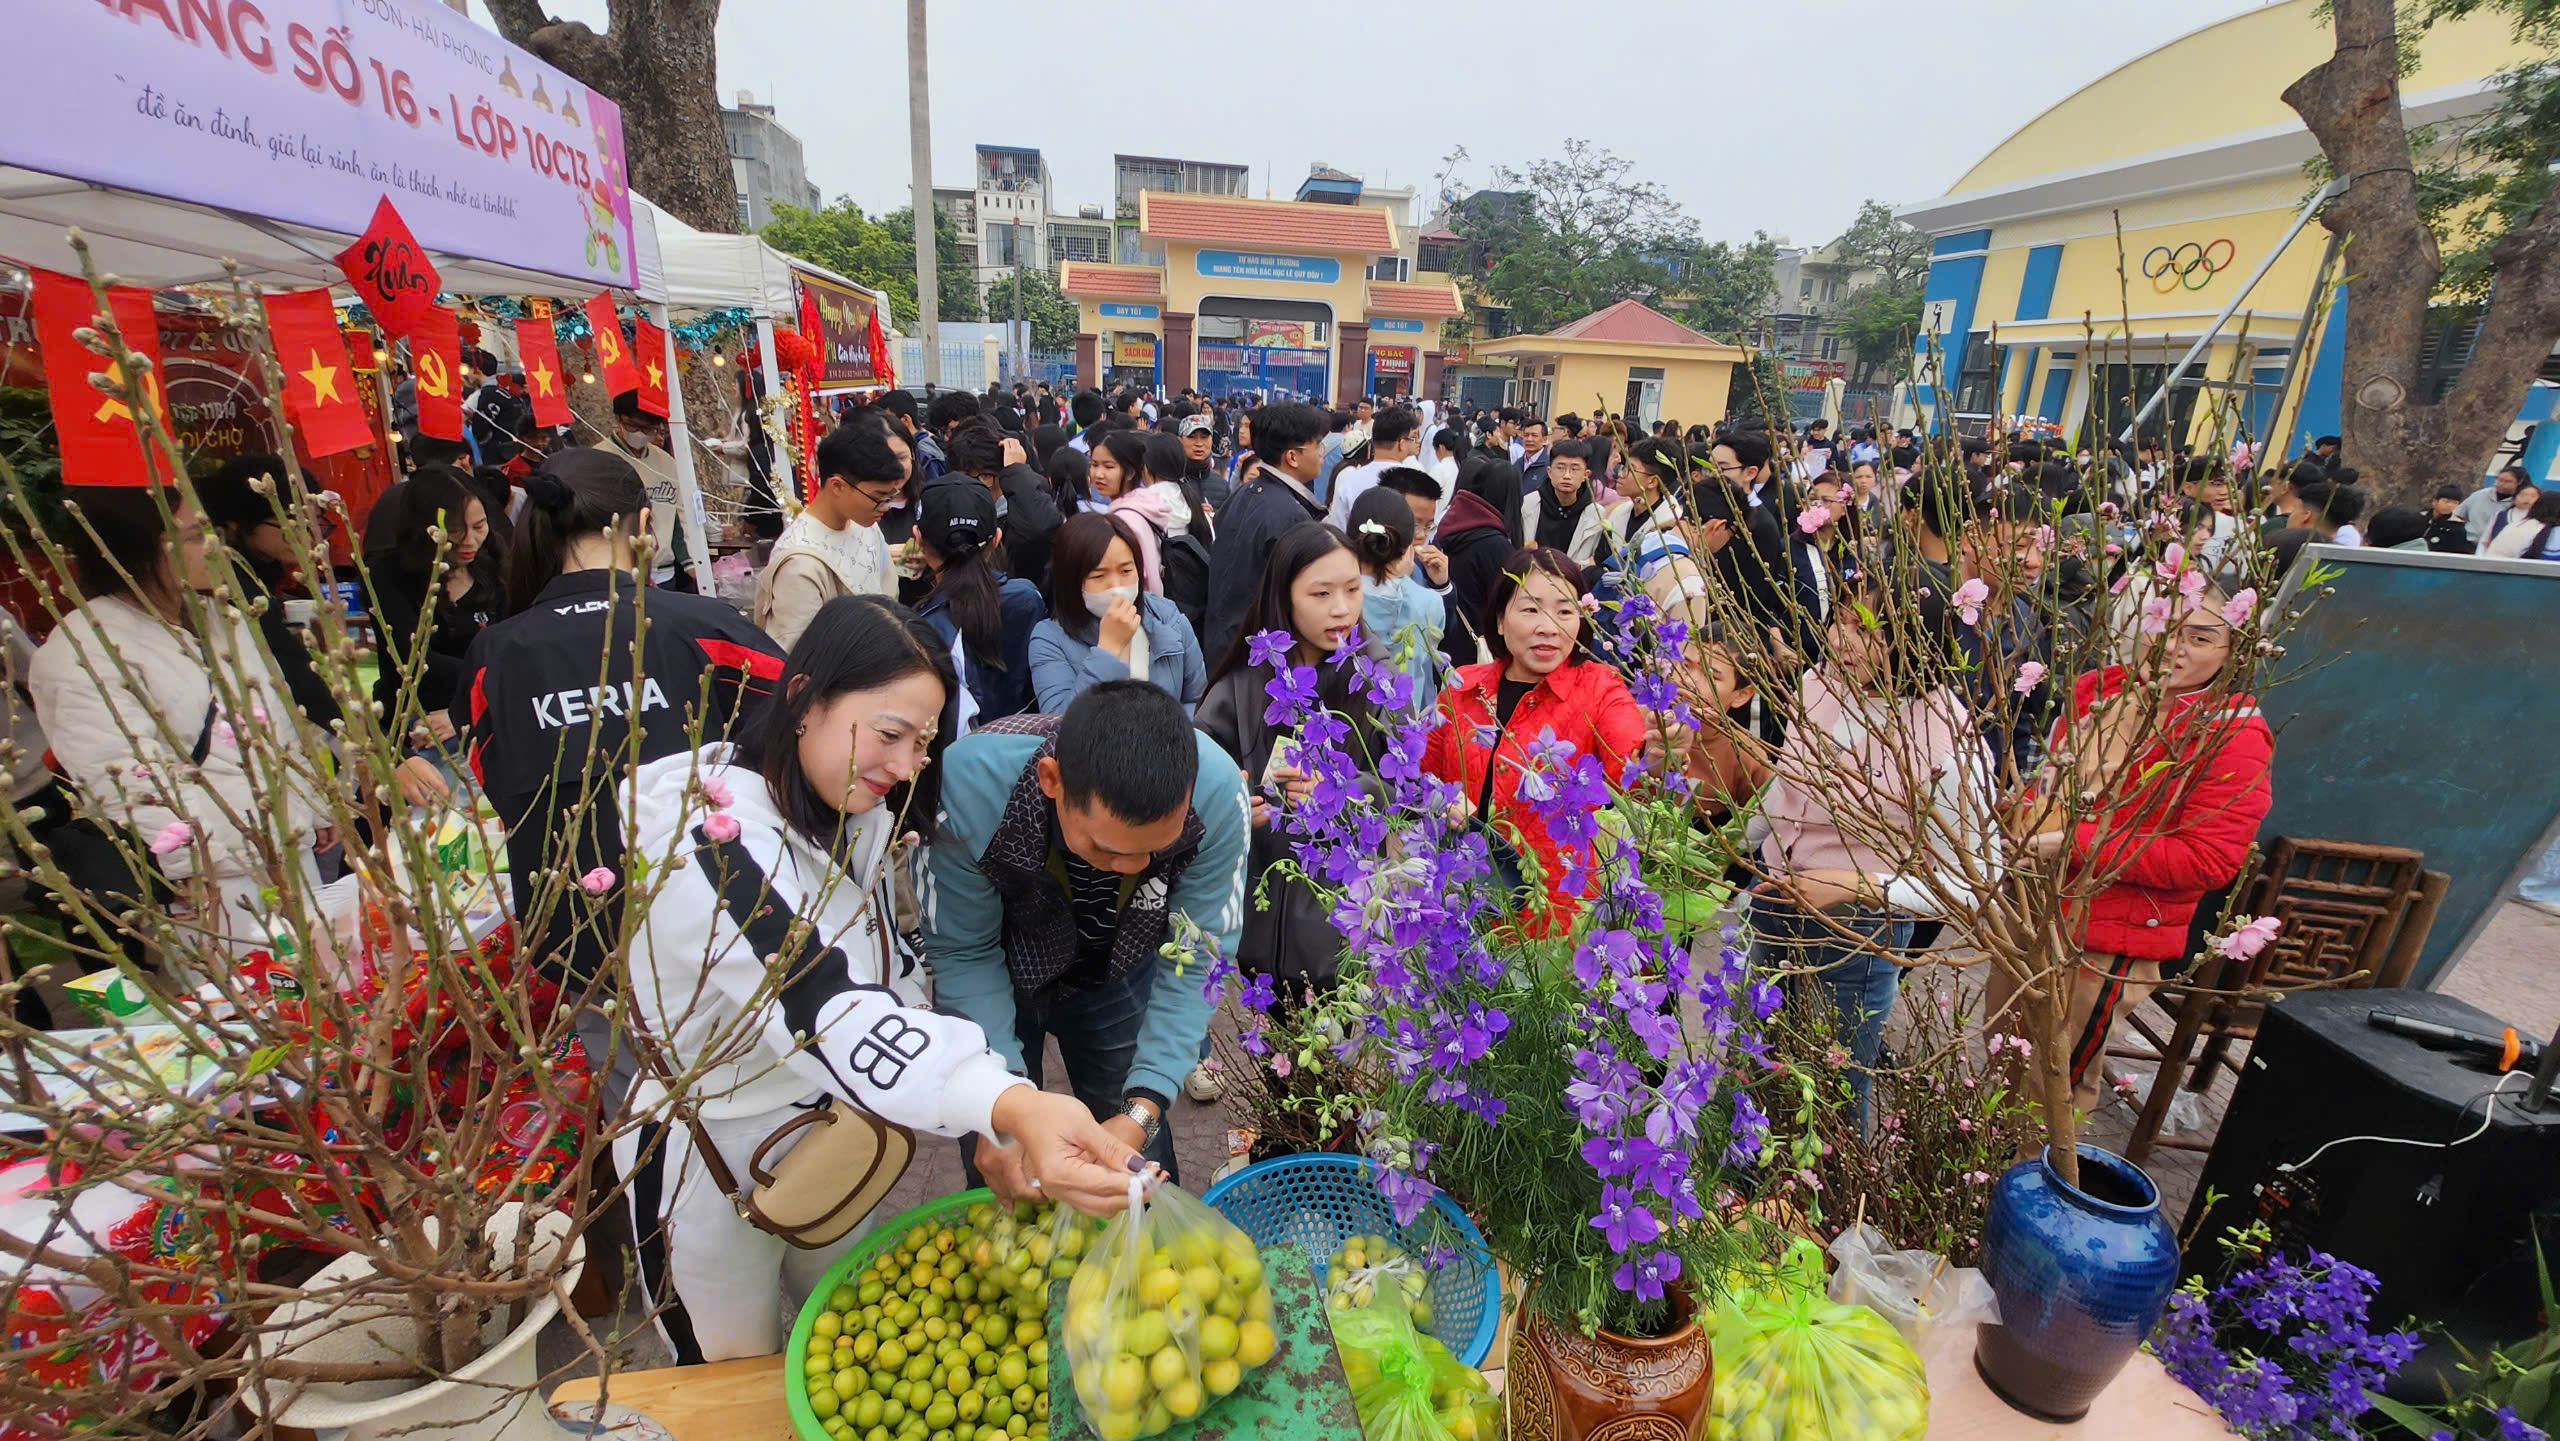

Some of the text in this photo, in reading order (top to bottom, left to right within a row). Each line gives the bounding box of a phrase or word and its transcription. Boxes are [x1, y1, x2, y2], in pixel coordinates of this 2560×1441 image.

[412, 16, 440, 48] HẢI
[443, 34, 494, 75] PHÒNG
[95, 0, 275, 68] NG
[288, 22, 363, 104] SỐ
[369, 57, 419, 126] 16
[450, 93, 517, 159] LỚP
[522, 125, 592, 190] 10C13
[137, 84, 166, 119] đồ
[175, 101, 203, 131] ăn
[268, 133, 297, 161] giá
[301, 133, 324, 168] lại
[370, 161, 389, 184] ăn
[393, 162, 406, 189] là
[363, 236, 429, 303] Xuân
[574, 600, 611, 614] LCK
[531, 677, 670, 730] KERIA
